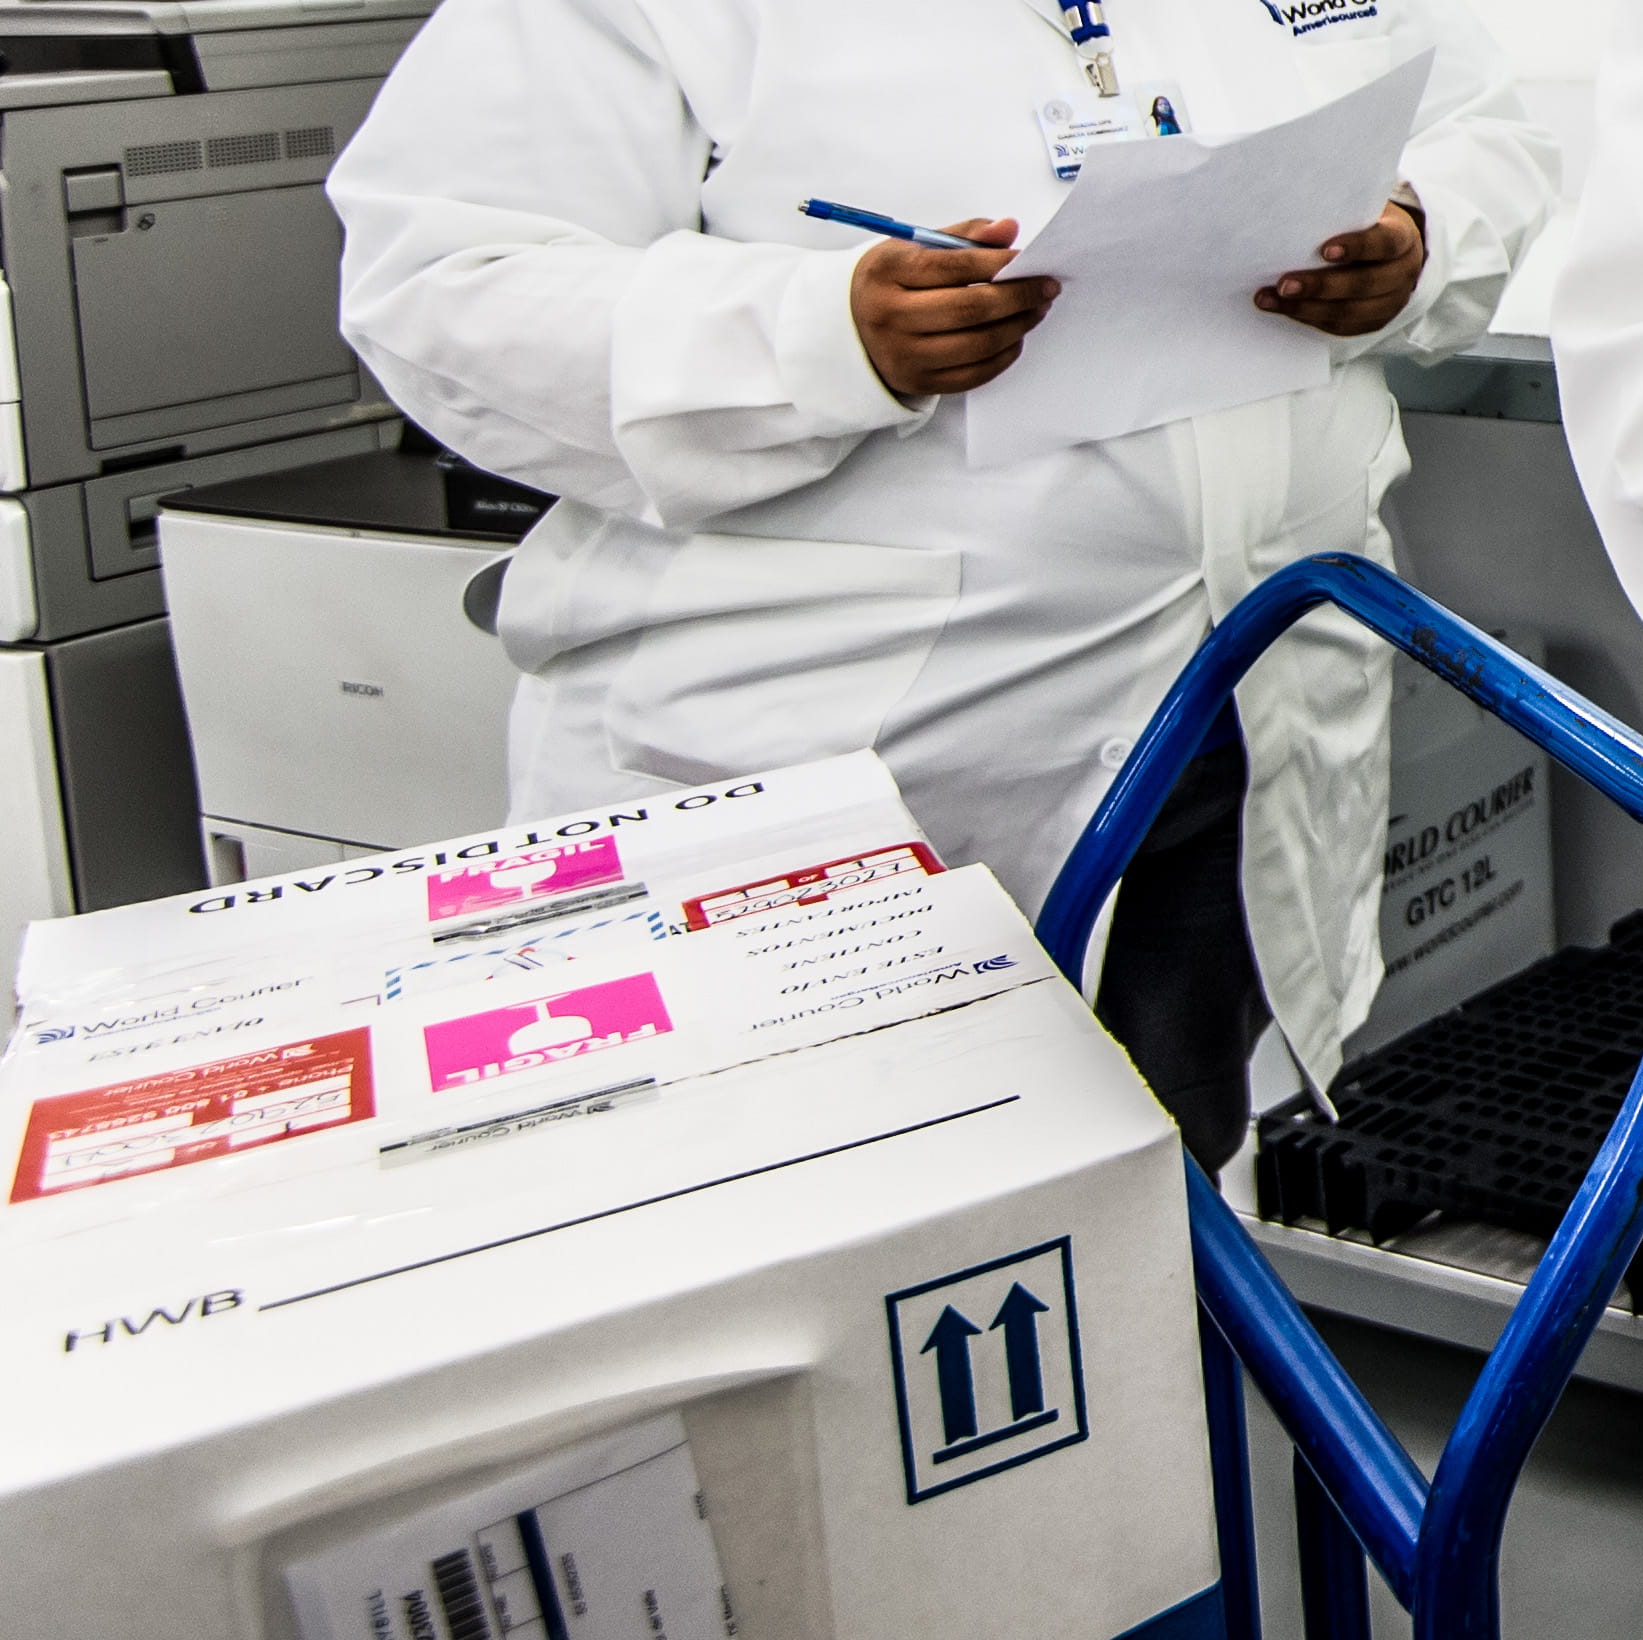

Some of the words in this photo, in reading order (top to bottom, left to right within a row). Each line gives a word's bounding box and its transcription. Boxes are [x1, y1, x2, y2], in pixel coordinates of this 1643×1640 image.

[674, 781, 766, 811] DO
[515, 808, 649, 849] NOT
[187, 840, 500, 916] DISCARD
[439, 840, 607, 884] FRAGIL
[1405, 878, 1456, 927] GTC
[875, 966, 970, 1001] World
[83, 1005, 180, 1034] World
[190, 978, 304, 1009] Courier
[751, 996, 865, 1031] Courier
[202, 1051, 278, 1077] World
[446, 1022, 657, 1083] FRAGIL
[102, 1070, 195, 1099] Courier
[278, 1063, 353, 1087] Phone
[61, 1287, 247, 1353] HWB
